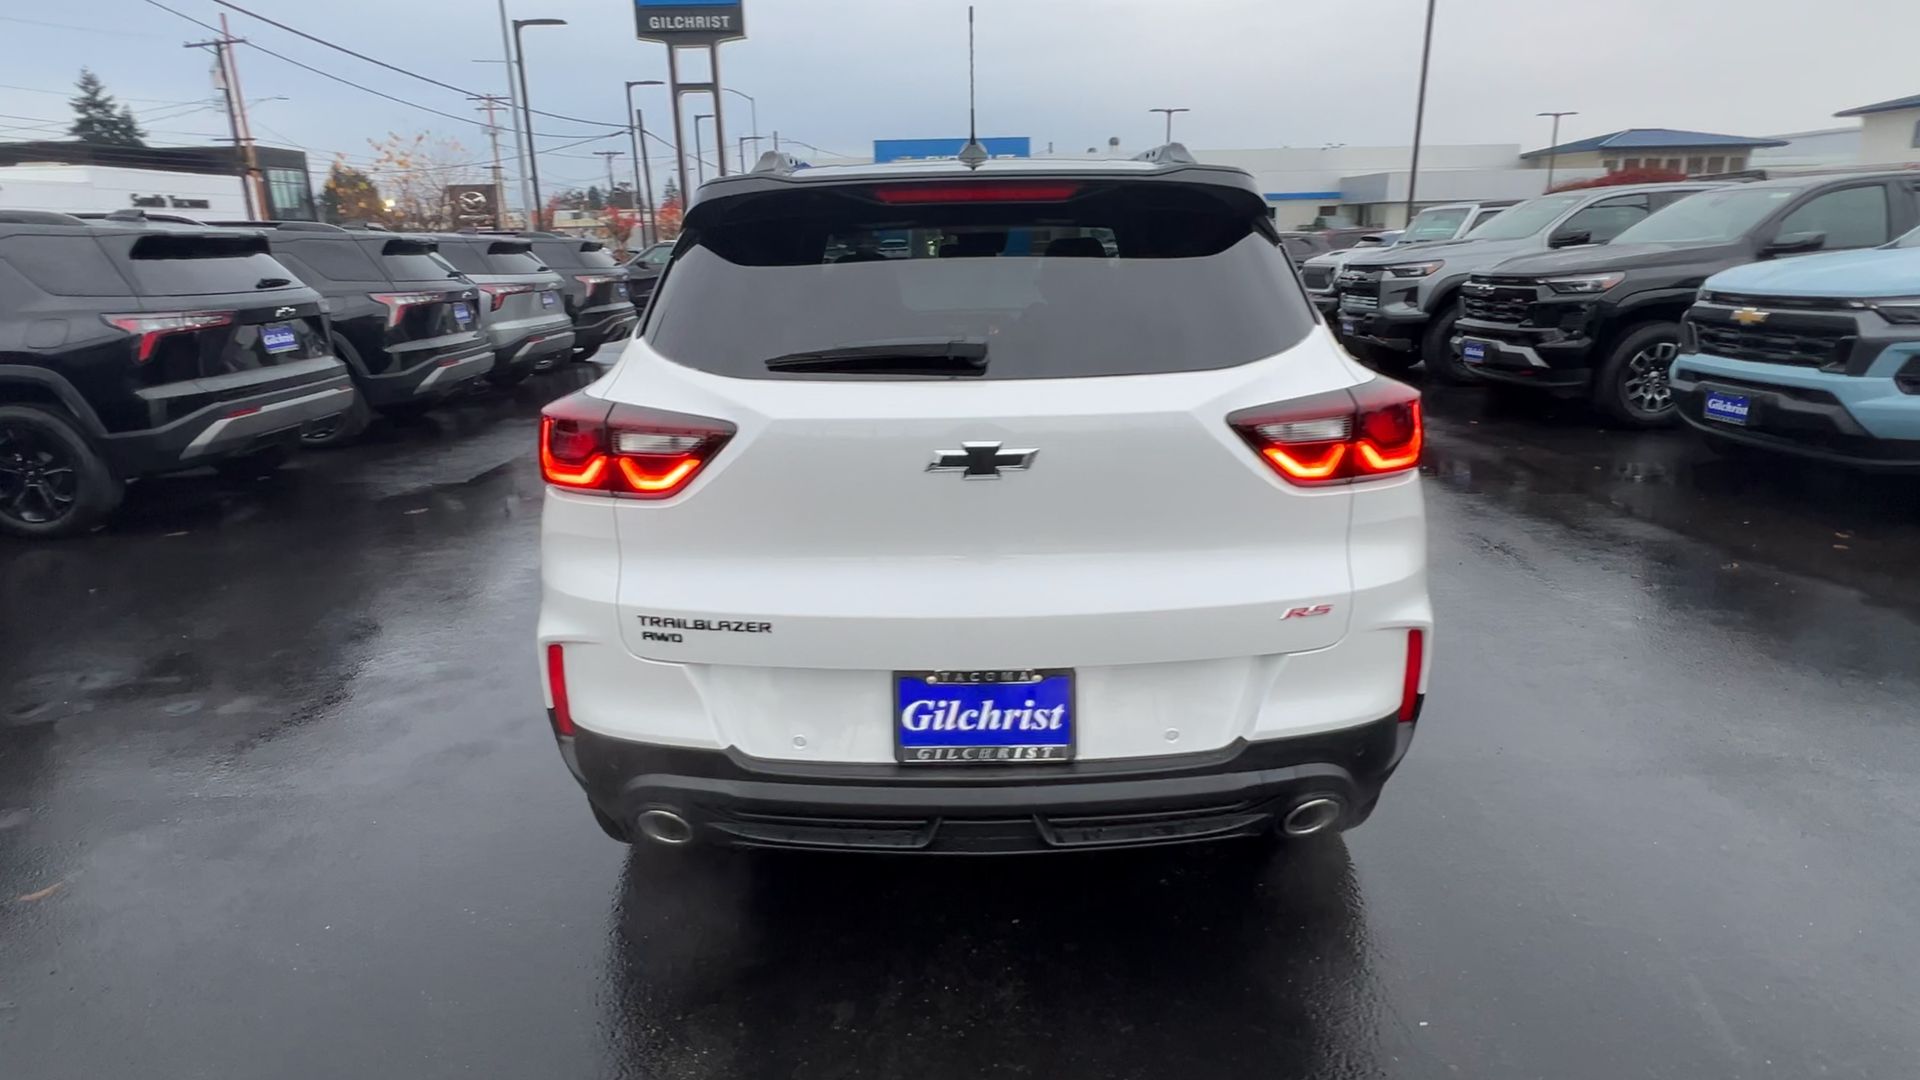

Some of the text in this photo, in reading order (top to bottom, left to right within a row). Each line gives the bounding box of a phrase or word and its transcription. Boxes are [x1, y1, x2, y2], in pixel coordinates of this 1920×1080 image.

[649, 15, 730, 29] GILCHRIST
[1708, 398, 1749, 415] Gilchrist
[1279, 603, 1333, 620] RS
[637, 615, 772, 633] TRAILBLAZER
[642, 631, 683, 643] AWD
[941, 672, 1031, 682] TACOMA
[901, 699, 1065, 731] Gilchrist
[916, 747, 1054, 760] GILCHRIST
